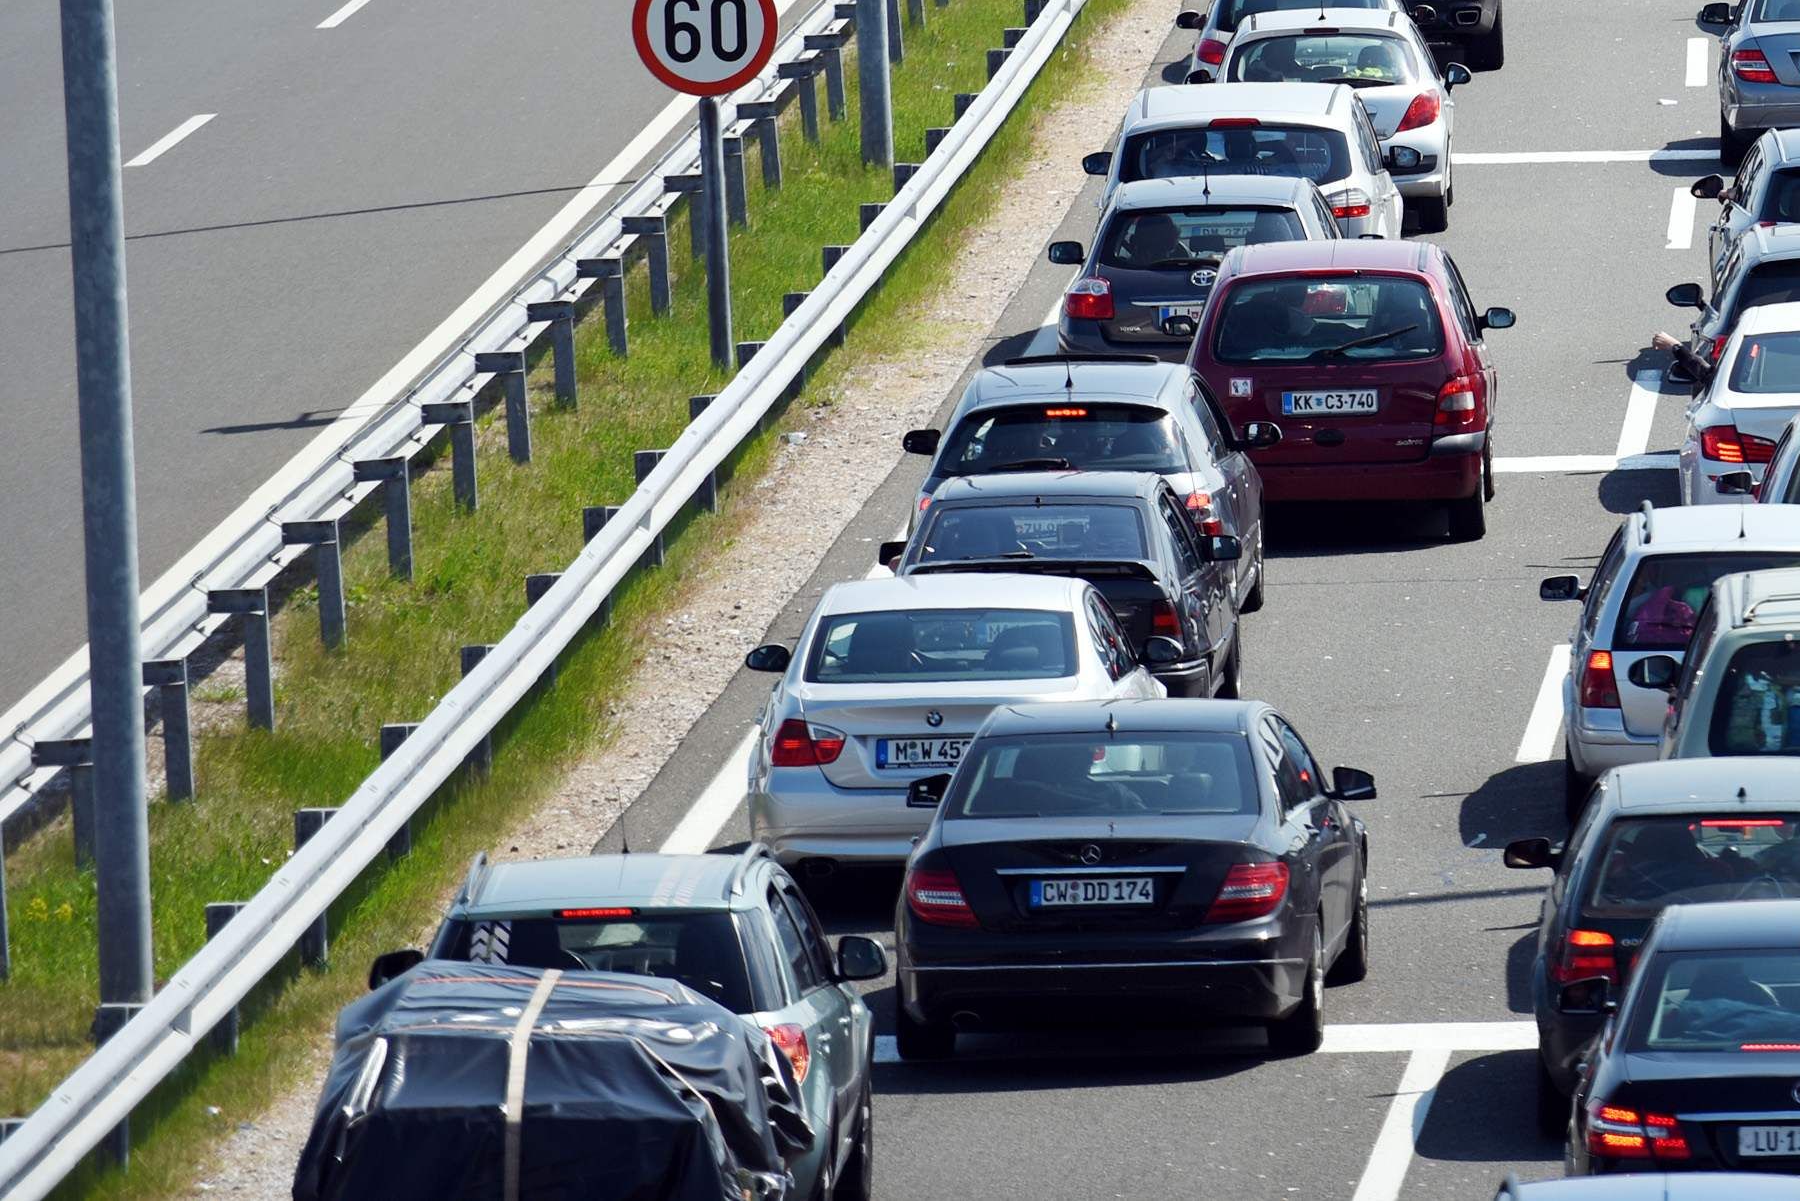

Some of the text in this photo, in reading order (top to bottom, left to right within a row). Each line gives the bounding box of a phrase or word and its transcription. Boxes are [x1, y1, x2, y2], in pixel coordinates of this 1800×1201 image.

[1293, 395, 1313, 410] KK
[895, 740, 972, 761] M W 45
[1043, 880, 1151, 902] CW DD 174
[1754, 1131, 1779, 1152] LU
